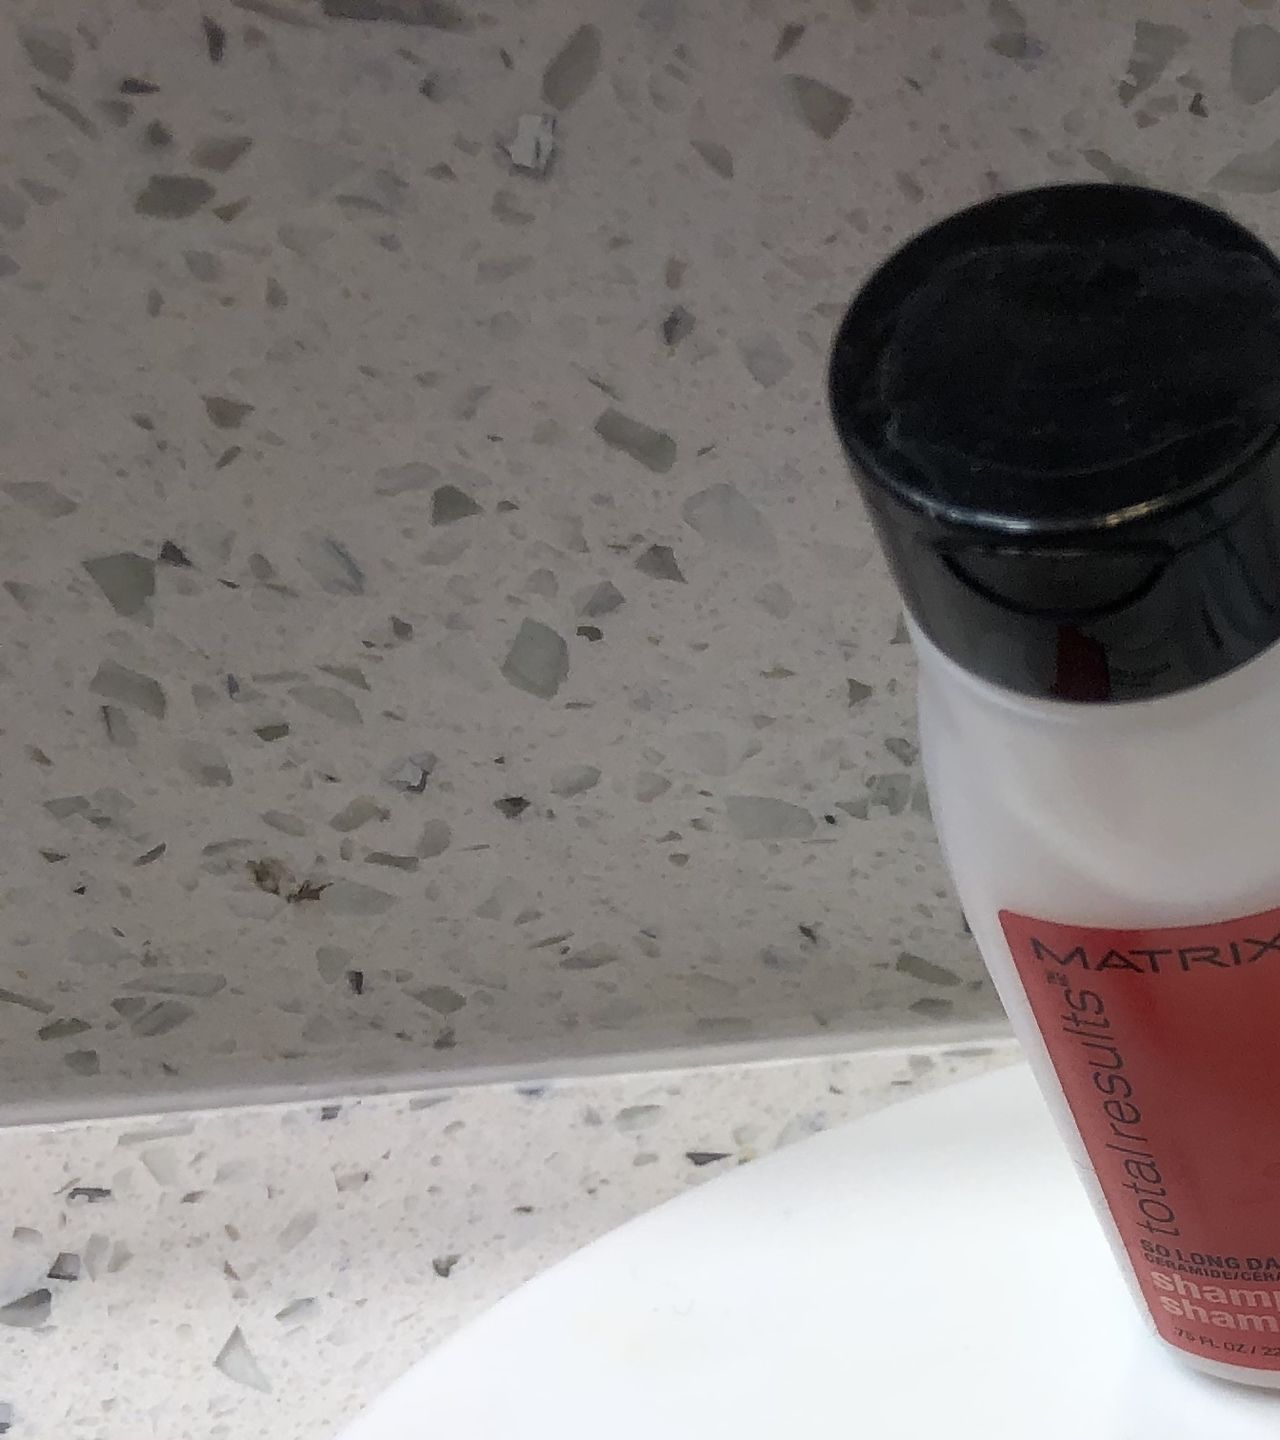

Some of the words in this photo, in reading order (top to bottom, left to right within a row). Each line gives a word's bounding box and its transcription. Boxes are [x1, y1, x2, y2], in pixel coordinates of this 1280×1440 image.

[1105, 1143, 1180, 1237] total
[1140, 1239, 1171, 1258] SO
[1176, 1250, 1242, 1270] LONG
